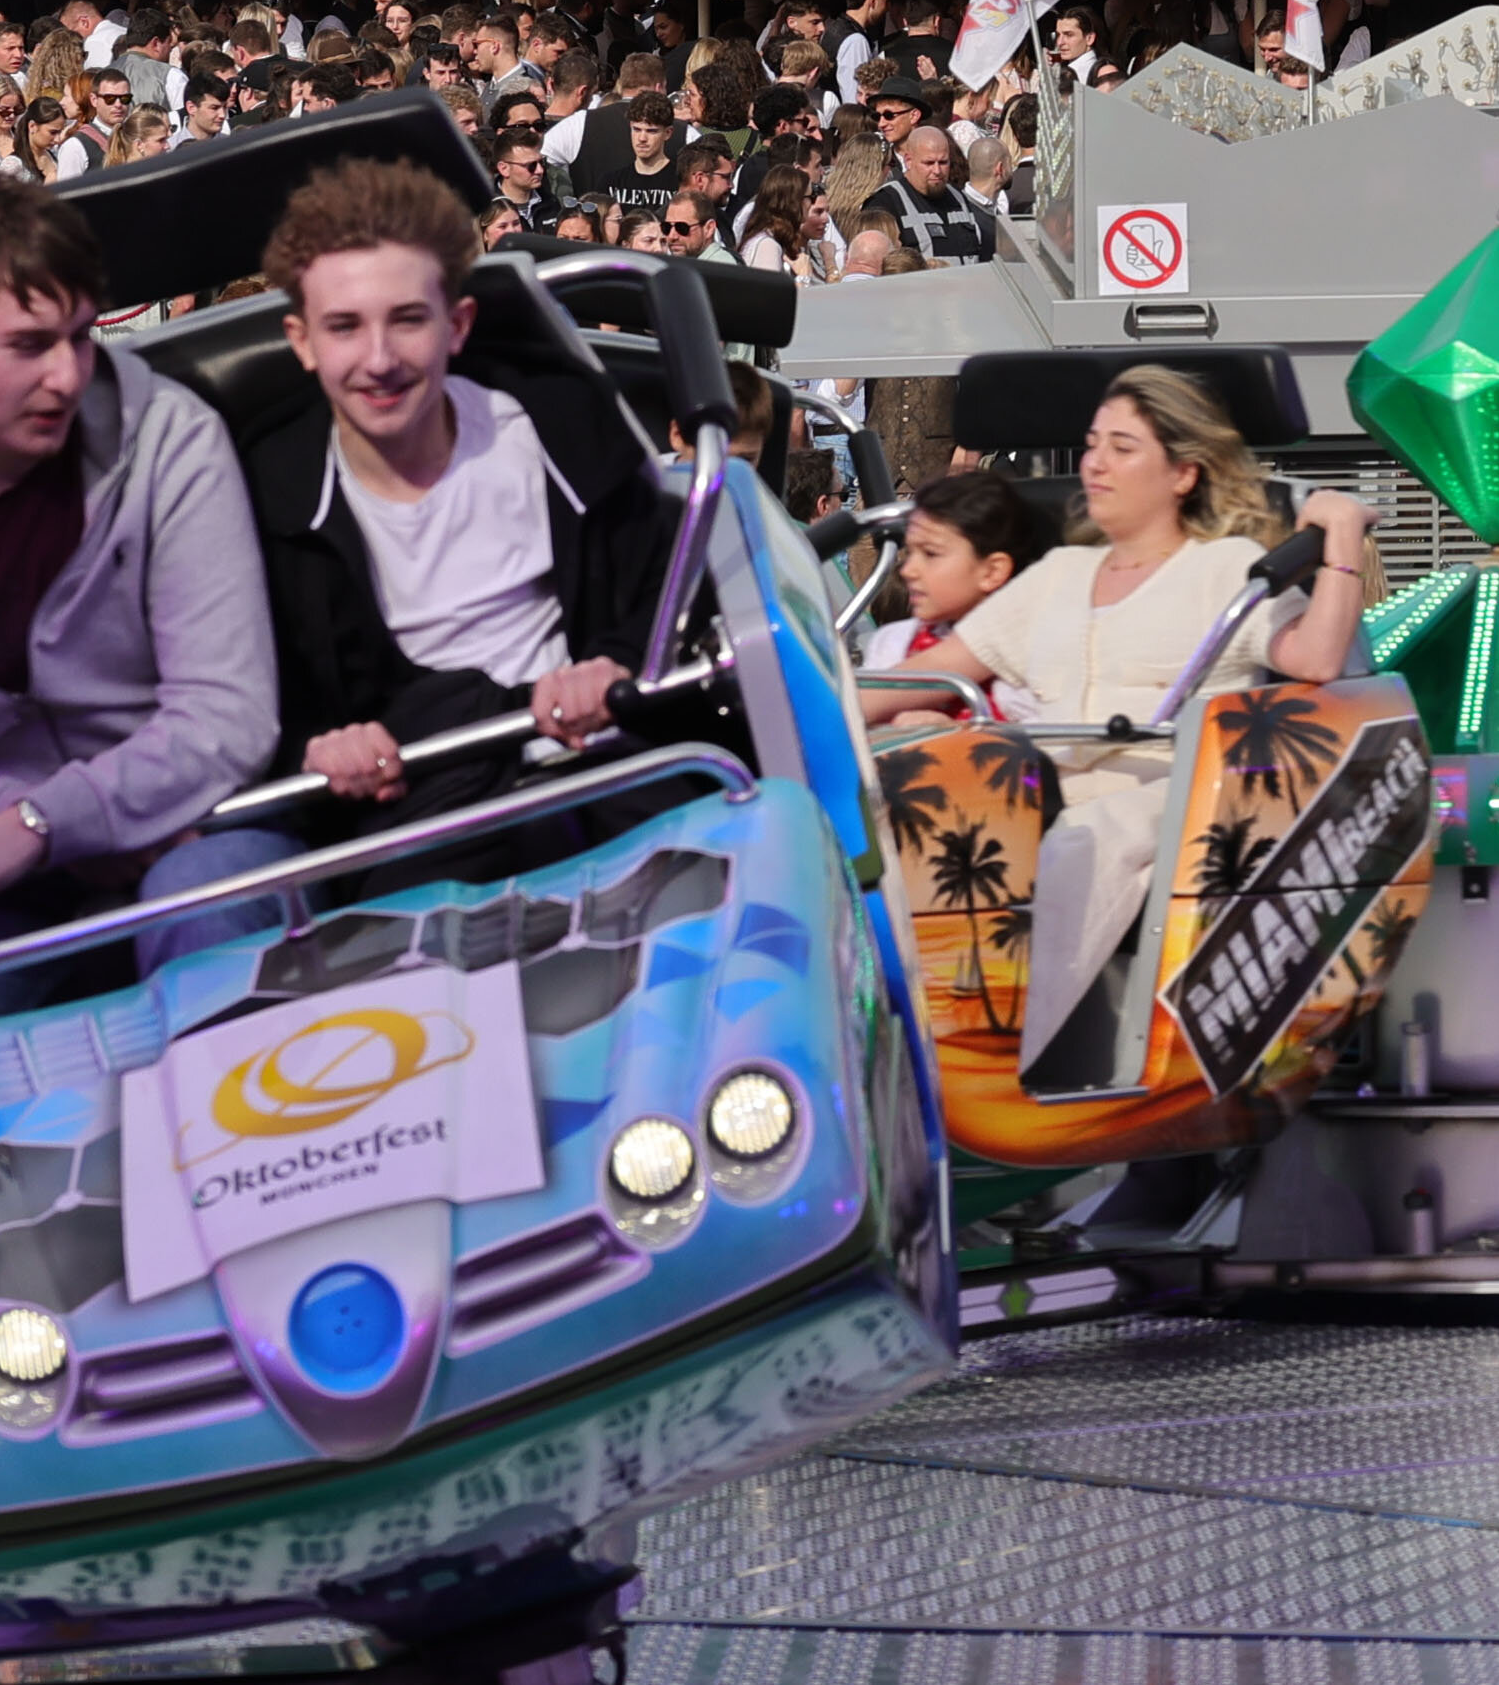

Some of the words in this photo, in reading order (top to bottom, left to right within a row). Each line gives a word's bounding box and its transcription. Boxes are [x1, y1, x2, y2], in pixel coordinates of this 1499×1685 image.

[1336, 735, 1428, 869] BEACH
[1186, 819, 1360, 1065] MIAMI
[191, 1117, 450, 1209] Oktoberfest
